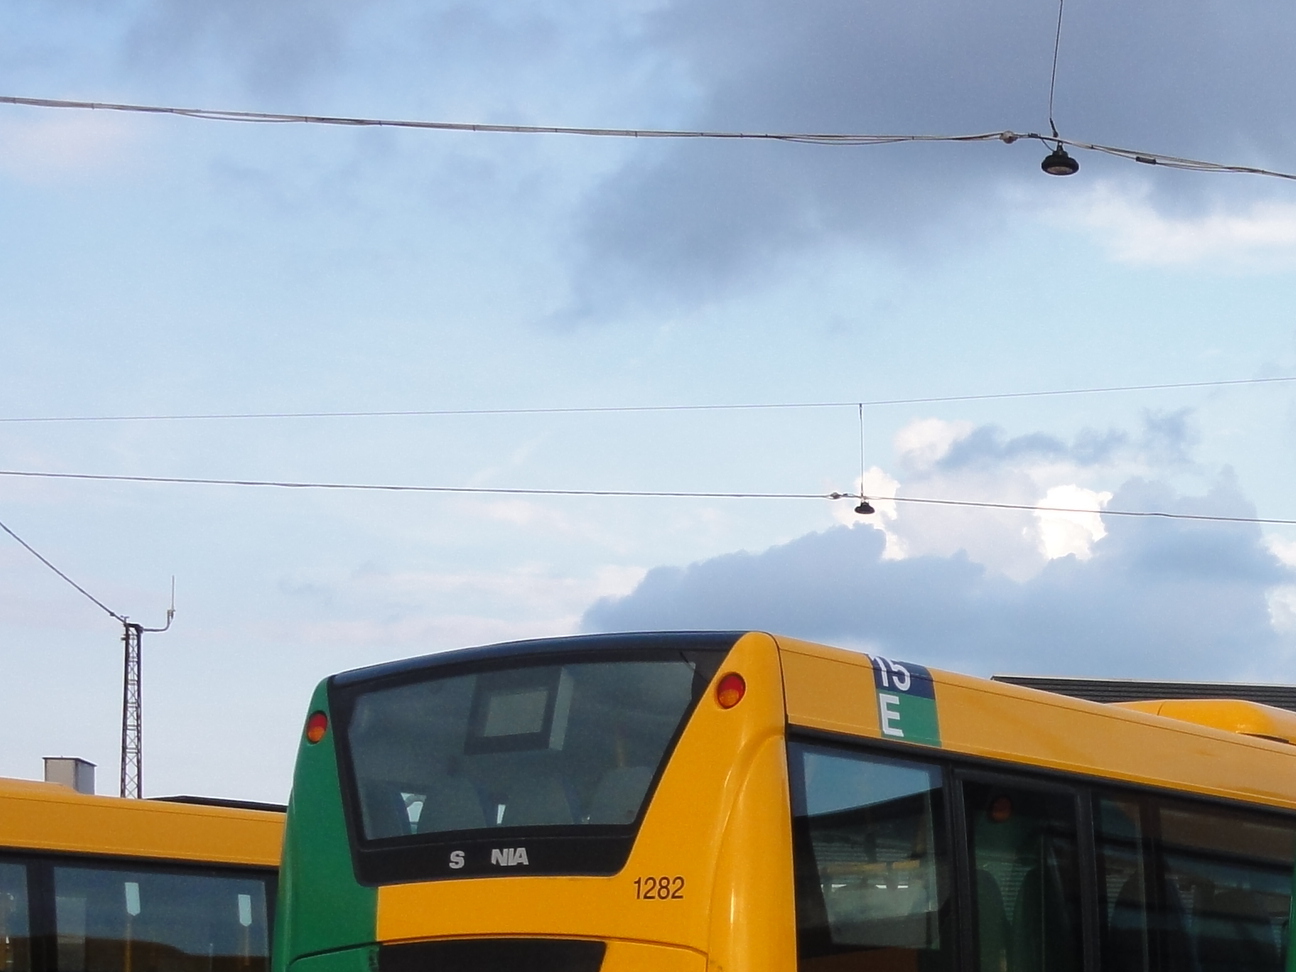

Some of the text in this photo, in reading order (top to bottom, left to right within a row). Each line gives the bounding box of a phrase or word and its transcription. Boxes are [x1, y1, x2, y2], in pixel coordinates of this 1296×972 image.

[874, 656, 911, 691] 15
[879, 693, 905, 737] E
[633, 876, 686, 899] 1282
